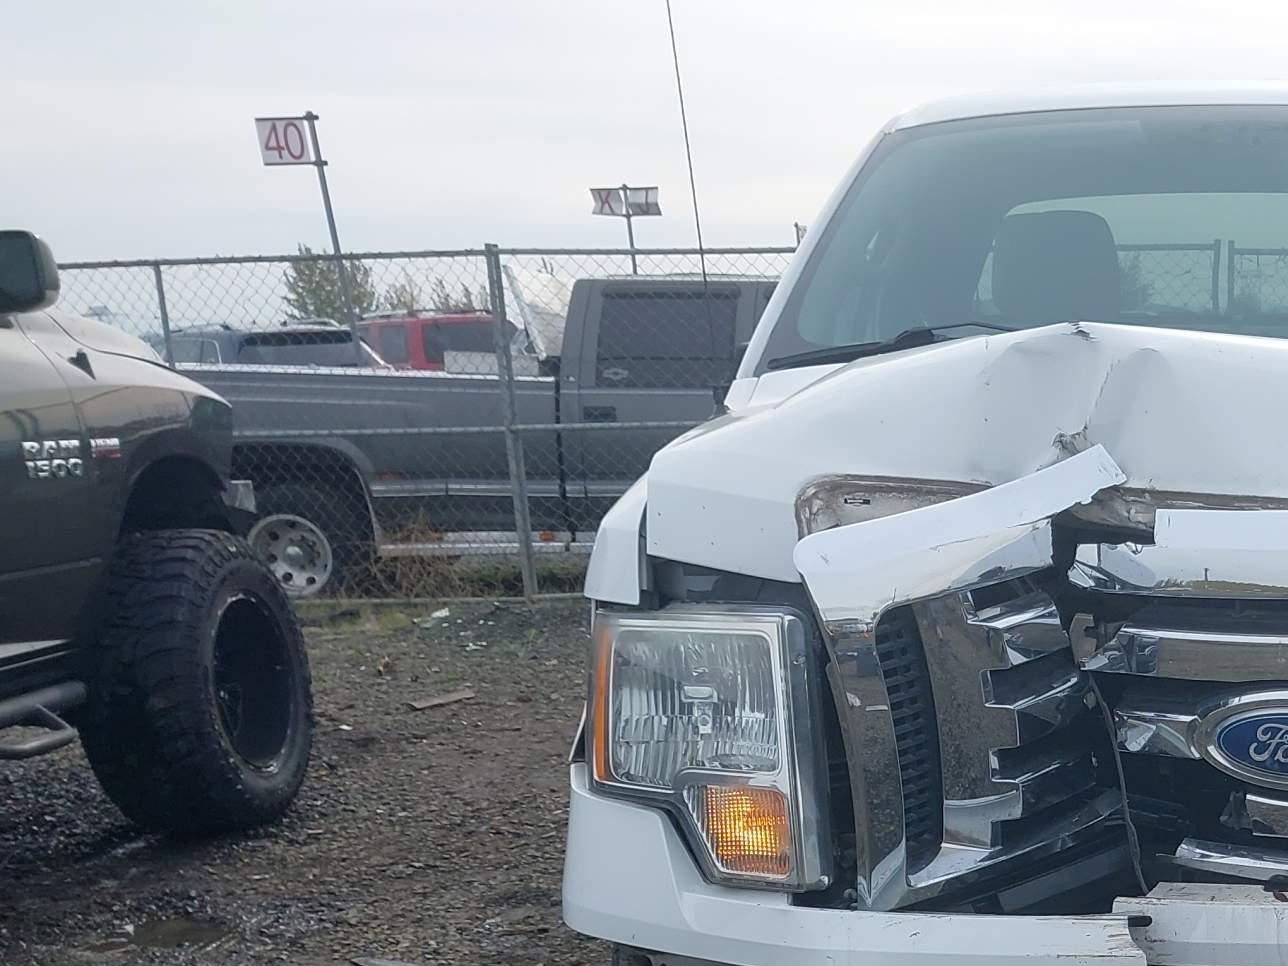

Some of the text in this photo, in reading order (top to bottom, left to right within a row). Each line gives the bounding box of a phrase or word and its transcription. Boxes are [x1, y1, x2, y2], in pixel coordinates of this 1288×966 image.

[264, 122, 304, 160] 40
[598, 191, 615, 214] K
[25, 458, 83, 479] 1500
